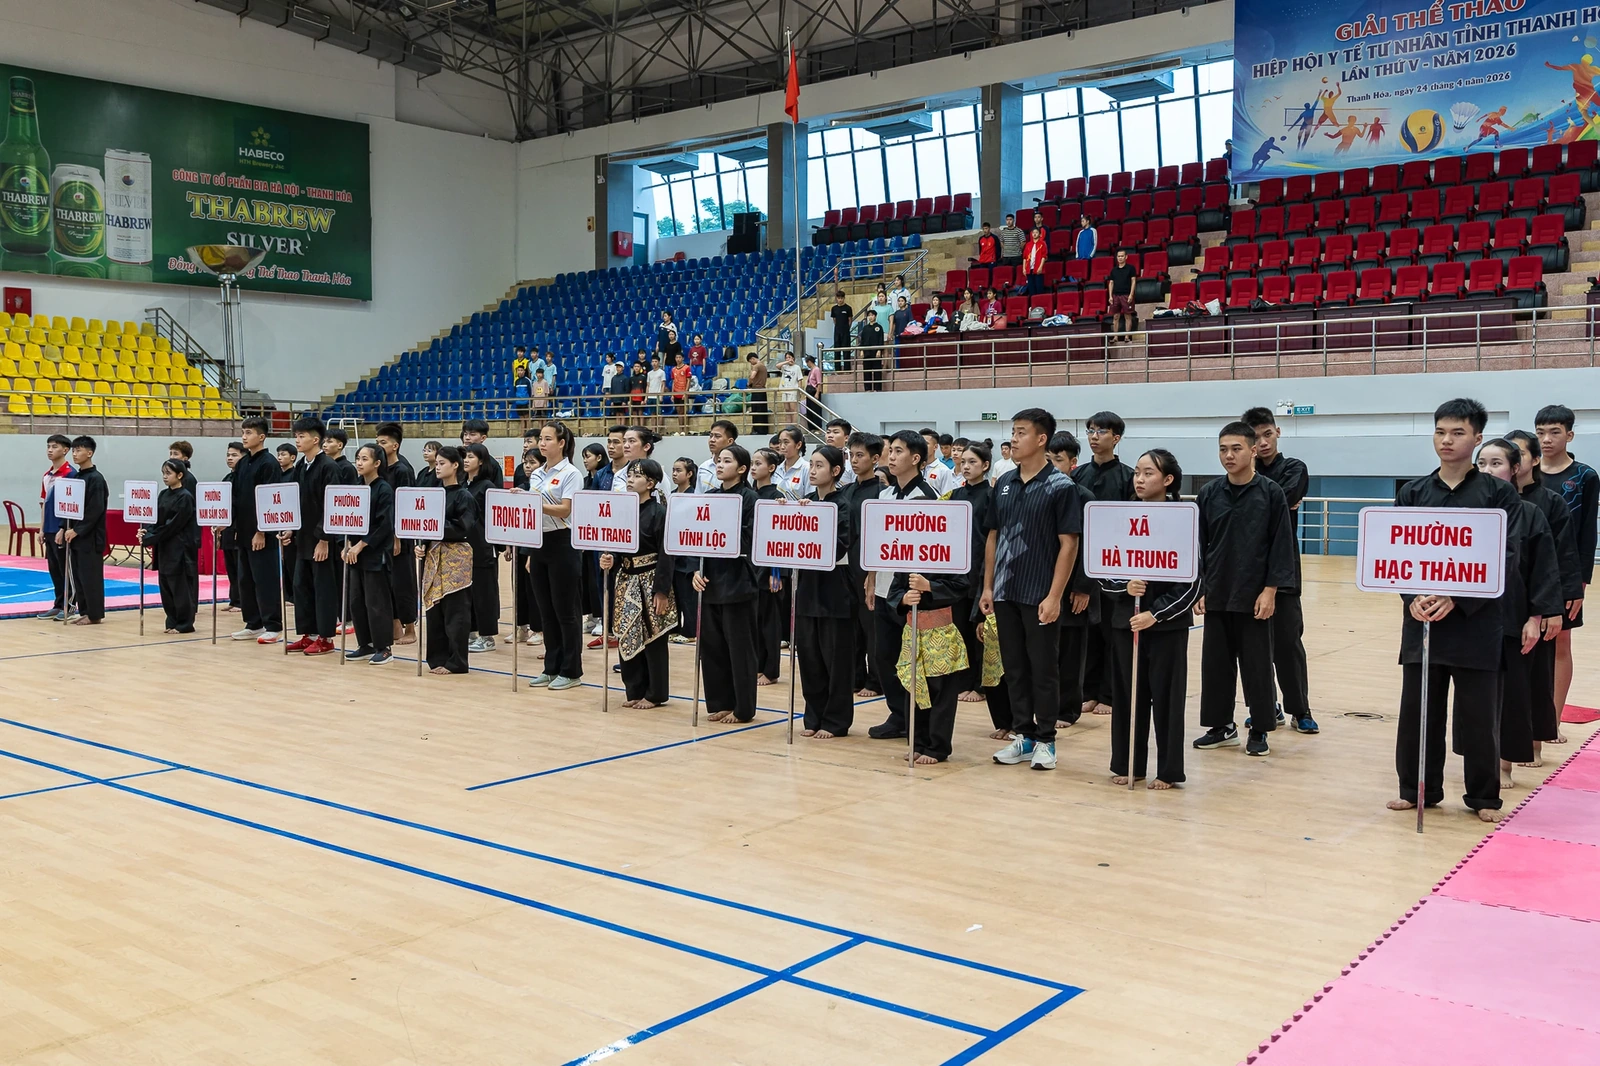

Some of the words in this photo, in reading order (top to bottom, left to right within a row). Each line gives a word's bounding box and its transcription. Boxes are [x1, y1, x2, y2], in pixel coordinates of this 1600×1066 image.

[1336, 14, 1387, 41] GIẢI
[1393, 0, 1444, 31] THỂ
[1449, 0, 1525, 20] THAO
[1253, 60, 1287, 79] HIỆP
[1292, 52, 1323, 73] HỘI
[1328, 51, 1338, 66] Y
[1344, 42, 1364, 63] TẾ
[1367, 41, 1390, 60] TƯ
[1394, 32, 1448, 56] NHÂN
[1454, 24, 1500, 45] TỈNH
[1505, 9, 1576, 36] THANH
[1582, 6, 1600, 25] H
[1342, 65, 1369, 82] LẦN
[1374, 59, 1404, 77] THỨ
[1408, 58, 1420, 72] V
[1433, 51, 1470, 68] NĂM
[1475, 44, 1515, 61] 2026
[1347, 95, 1370, 103] Thanh
[1373, 91, 1392, 100] Hóa,
[1394, 88, 1414, 97] ngày
[1416, 85, 1428, 93] 24
[1430, 81, 1454, 91] tháng
[1456, 79, 1462, 87] 4
[1465, 78, 1483, 86] năm
[1486, 72, 1511, 83] 2026
[239, 147, 284, 161] HABECO
[173, 169, 198, 183] CÔNG
[200, 174, 210, 184] TY
[213, 172, 226, 186] CỔ
[254, 181, 268, 193] BIA
[270, 181, 282, 194] HÀ
[284, 183, 299, 197] NỘI
[306, 187, 333, 199] THANH
[336, 190, 352, 203] HÓA
[2, 191, 48, 205] THABREW
[55, 208, 101, 223] THABREW
[187, 192, 335, 233] THABREW
[227, 232, 304, 256] SILVER
[168, 256, 196, 274] Đồng
[258, 265, 276, 279] Thể
[277, 267, 299, 280] Thao
[302, 270, 330, 283] Thanh
[332, 273, 352, 286] Hóa
[131, 487, 150, 499] PHƯỜNG
[204, 489, 221, 501] PHƯỜNG
[334, 493, 360, 507] PHƯỜNG
[415, 495, 425, 510] XÃ
[142, 506, 153, 517] SƠN
[219, 507, 228, 519] SƠN
[263, 509, 279, 523] TỐNG
[280, 511, 293, 523] SƠN
[330, 513, 344, 526] HÀM
[492, 506, 520, 532] TRỌNG
[522, 504, 536, 531] TÀI
[598, 501, 611, 518] XÃ
[696, 504, 710, 521] XÃ
[401, 518, 421, 531] MINH
[423, 518, 438, 531] SƠN
[772, 512, 818, 532] PHƯỜNG
[885, 511, 947, 533] PHƯỜNG
[1129, 515, 1150, 537] XÃ
[578, 524, 599, 541] TIÊN
[601, 528, 632, 544] TRANG
[679, 528, 703, 546] VĨNH
[706, 530, 726, 550] LỘC
[1391, 521, 1472, 547] PHƯỜNG
[767, 541, 794, 558] NGHI
[797, 542, 822, 559] SƠN
[880, 538, 914, 561] SẦM
[919, 544, 951, 562] SƠN
[1102, 545, 1121, 567] HÀ
[1126, 550, 1178, 570] TRUNG
[1374, 559, 1413, 584] HẠC
[1419, 558, 1487, 584] THÀNH
